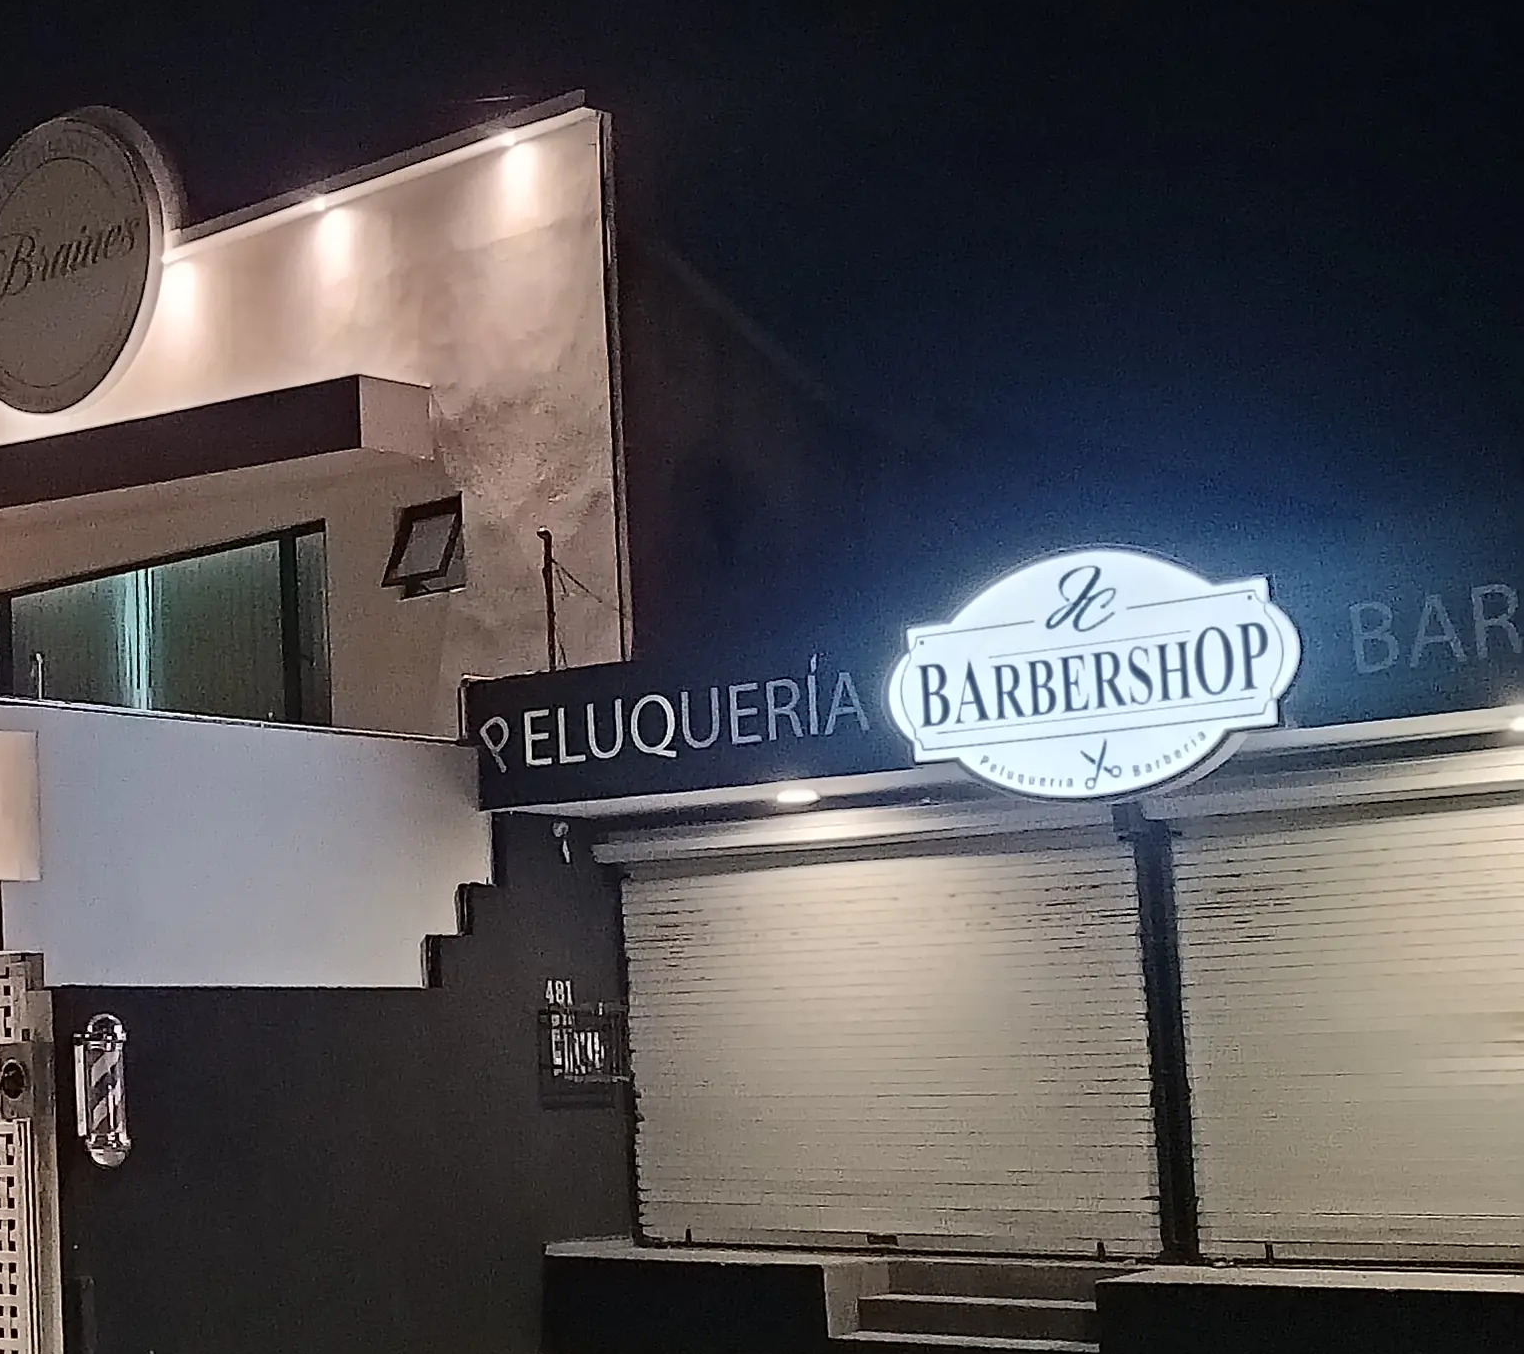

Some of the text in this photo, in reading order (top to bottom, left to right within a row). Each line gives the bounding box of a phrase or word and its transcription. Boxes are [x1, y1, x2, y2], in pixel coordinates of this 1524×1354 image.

[918, 621, 1270, 728] BARBERSHOP
[1349, 583, 1522, 674] BAR
[478, 652, 870, 774] PELUQUERÍA
[544, 979, 574, 1006] 481
